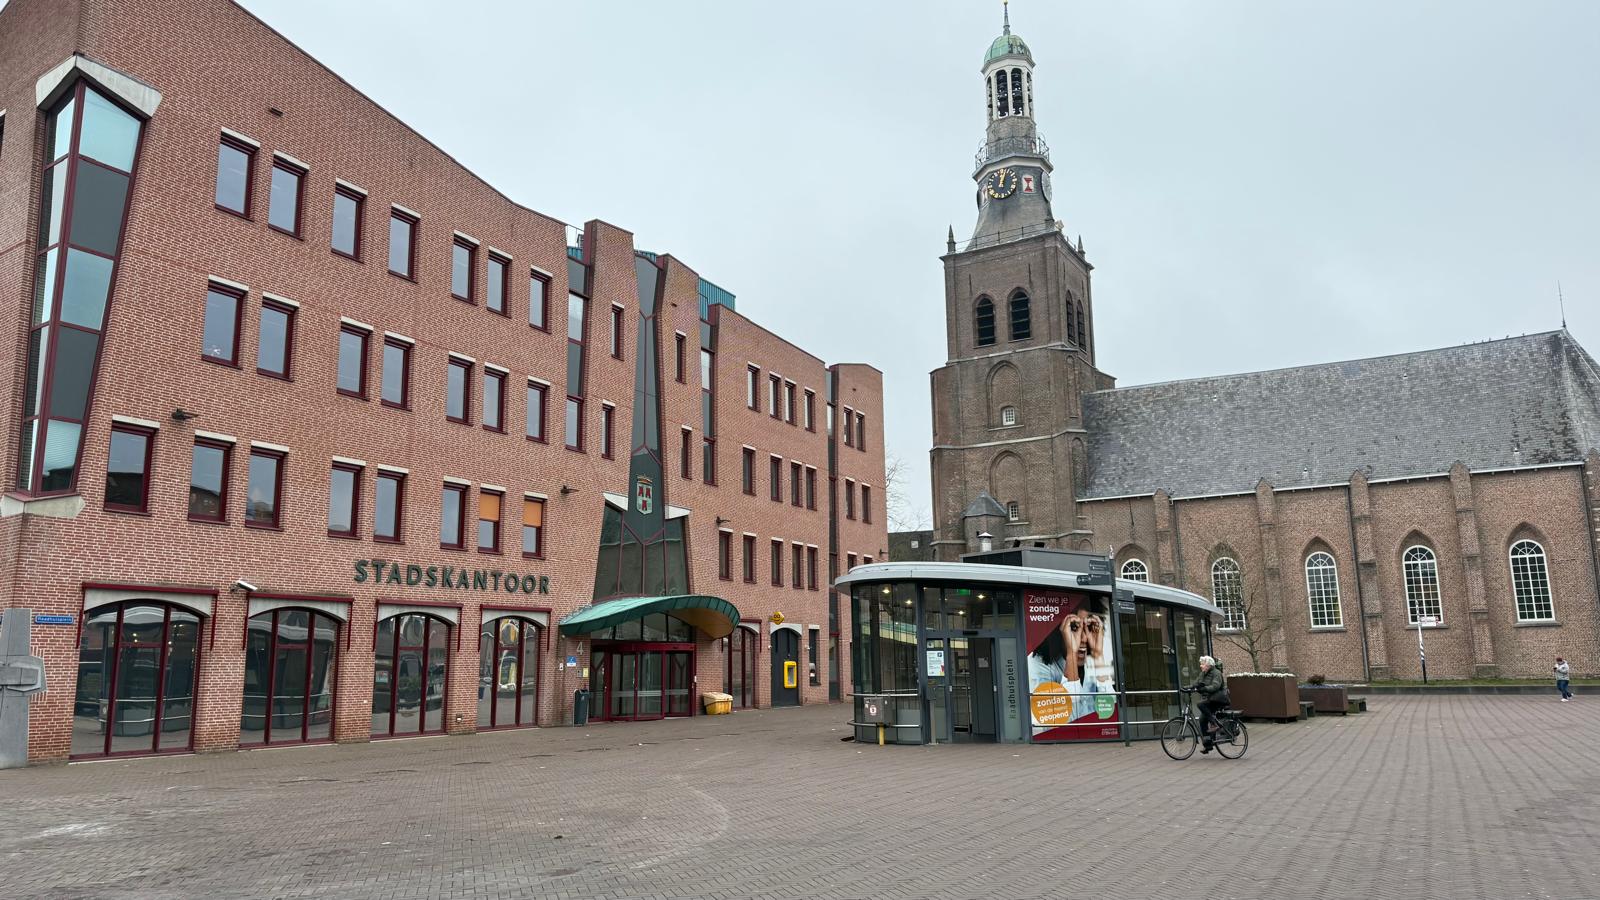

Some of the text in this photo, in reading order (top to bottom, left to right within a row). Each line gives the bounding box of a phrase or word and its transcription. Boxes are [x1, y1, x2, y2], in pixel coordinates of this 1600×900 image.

[354, 558, 550, 594] STADSKANTOOR
[1028, 594, 1069, 606] Zien we je
[1029, 603, 1060, 615] zondag
[1029, 613, 1055, 622] weer?
[576, 641, 584, 656] 4
[1006, 658, 1017, 719] Raadhuisplein
[1037, 696, 1066, 708] zondag
[1040, 711, 1068, 723] geopend
